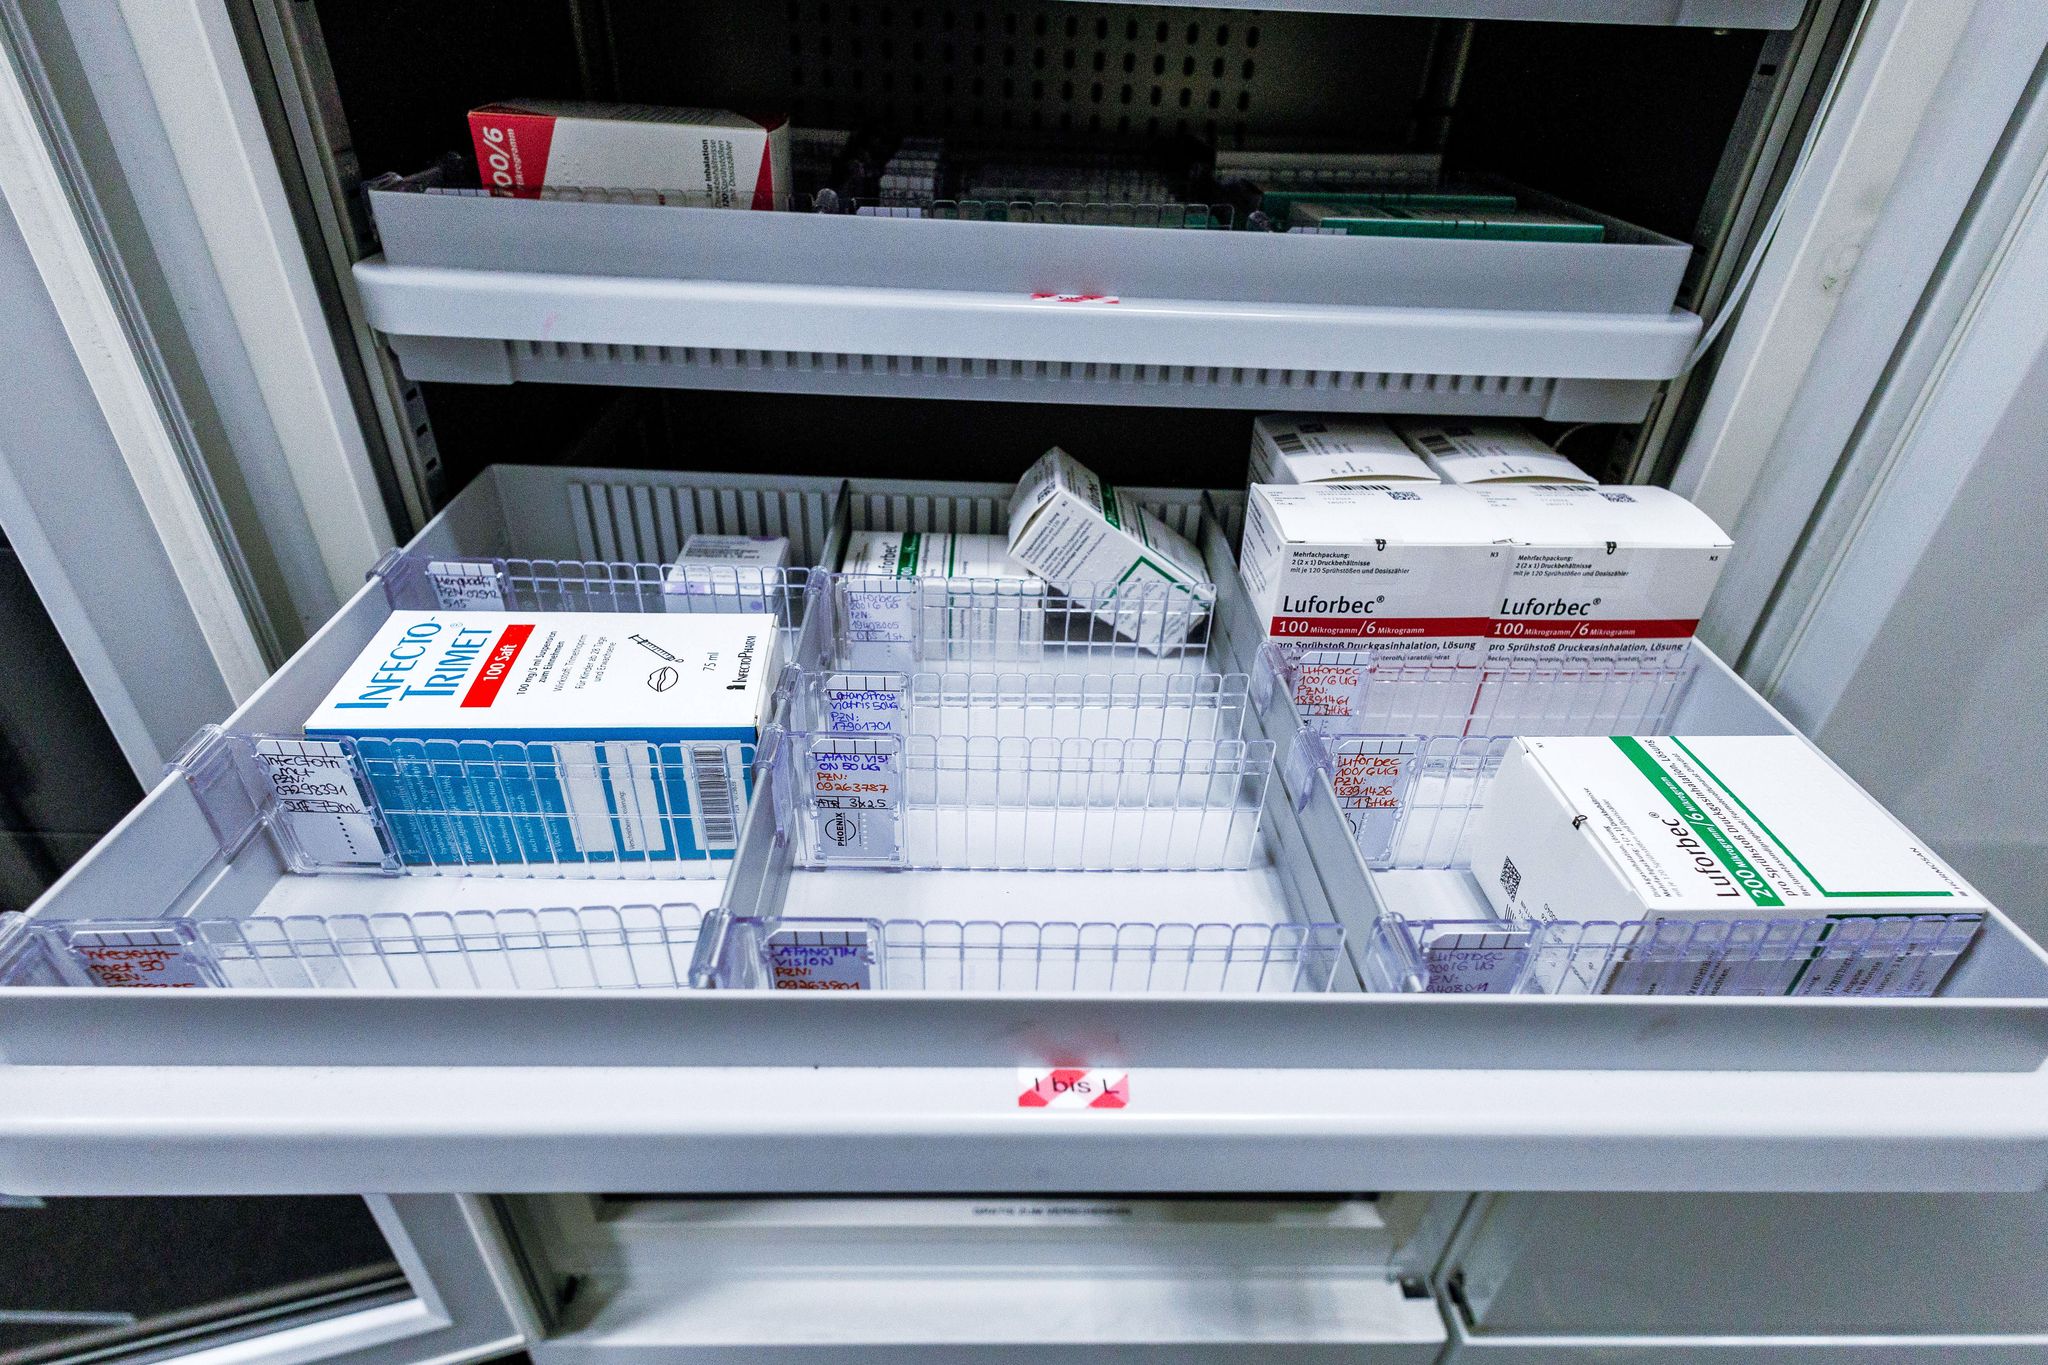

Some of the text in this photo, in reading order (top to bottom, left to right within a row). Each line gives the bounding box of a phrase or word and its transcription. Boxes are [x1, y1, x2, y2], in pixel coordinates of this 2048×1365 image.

[1293, 551, 1350, 560] Mehrfachpackung:
[1518, 555, 1573, 563] Mehrfachpackung:
[1317, 559, 1370, 567] Druckbehältnisse
[1279, 621, 1309, 633] 100
[1377, 626, 1425, 635] Mikrogramm
[1493, 623, 1524, 635] 100
[1589, 629, 1636, 637] Mikrogramm
[592, 636, 609, 646] Tage
[1442, 641, 1476, 651] Lösung
[1489, 643, 1505, 653] pro
[1507, 642, 1556, 652] Sprühstoß
[1650, 641, 1684, 651] Lösung
[563, 634, 591, 666] Trimethoprim
[481, 643, 519, 680] 100 Saft
[514, 683, 532, 695] 100
[533, 630, 560, 657] Suspension
[536, 641, 566, 682] zum Einnehmen
[590, 642, 617, 681] und Erwachsene
[701, 652, 719, 670] 75 ml
[577, 663, 595, 679] Kinder
[573, 680, 588, 688] Für
[1298, 685, 1328, 695] PZN:
[831, 712, 859, 722] PZN:
[832, 721, 891, 731] 17901701
[1645, 739, 1671, 762] Lösung
[815, 753, 860, 762] LATANO
[817, 772, 847, 781] PZN:
[1334, 777, 1366, 786] PZN:
[276, 783, 348, 796] 07298391
[817, 782, 888, 793] 09263787
[1334, 786, 1392, 796] 18391426
[1656, 776, 1699, 811] Mikrogramm
[836, 812, 845, 846] PHOENIX
[1729, 834, 1782, 878] Sprühstoß
[1731, 869, 1775, 897] 200
[1772, 881, 1799, 896] pro
[138, 960, 164, 972] 50
[775, 958, 834, 966] VISION
[1052, 1077, 1091, 1093] bis
[1103, 1078, 1119, 1093] L
